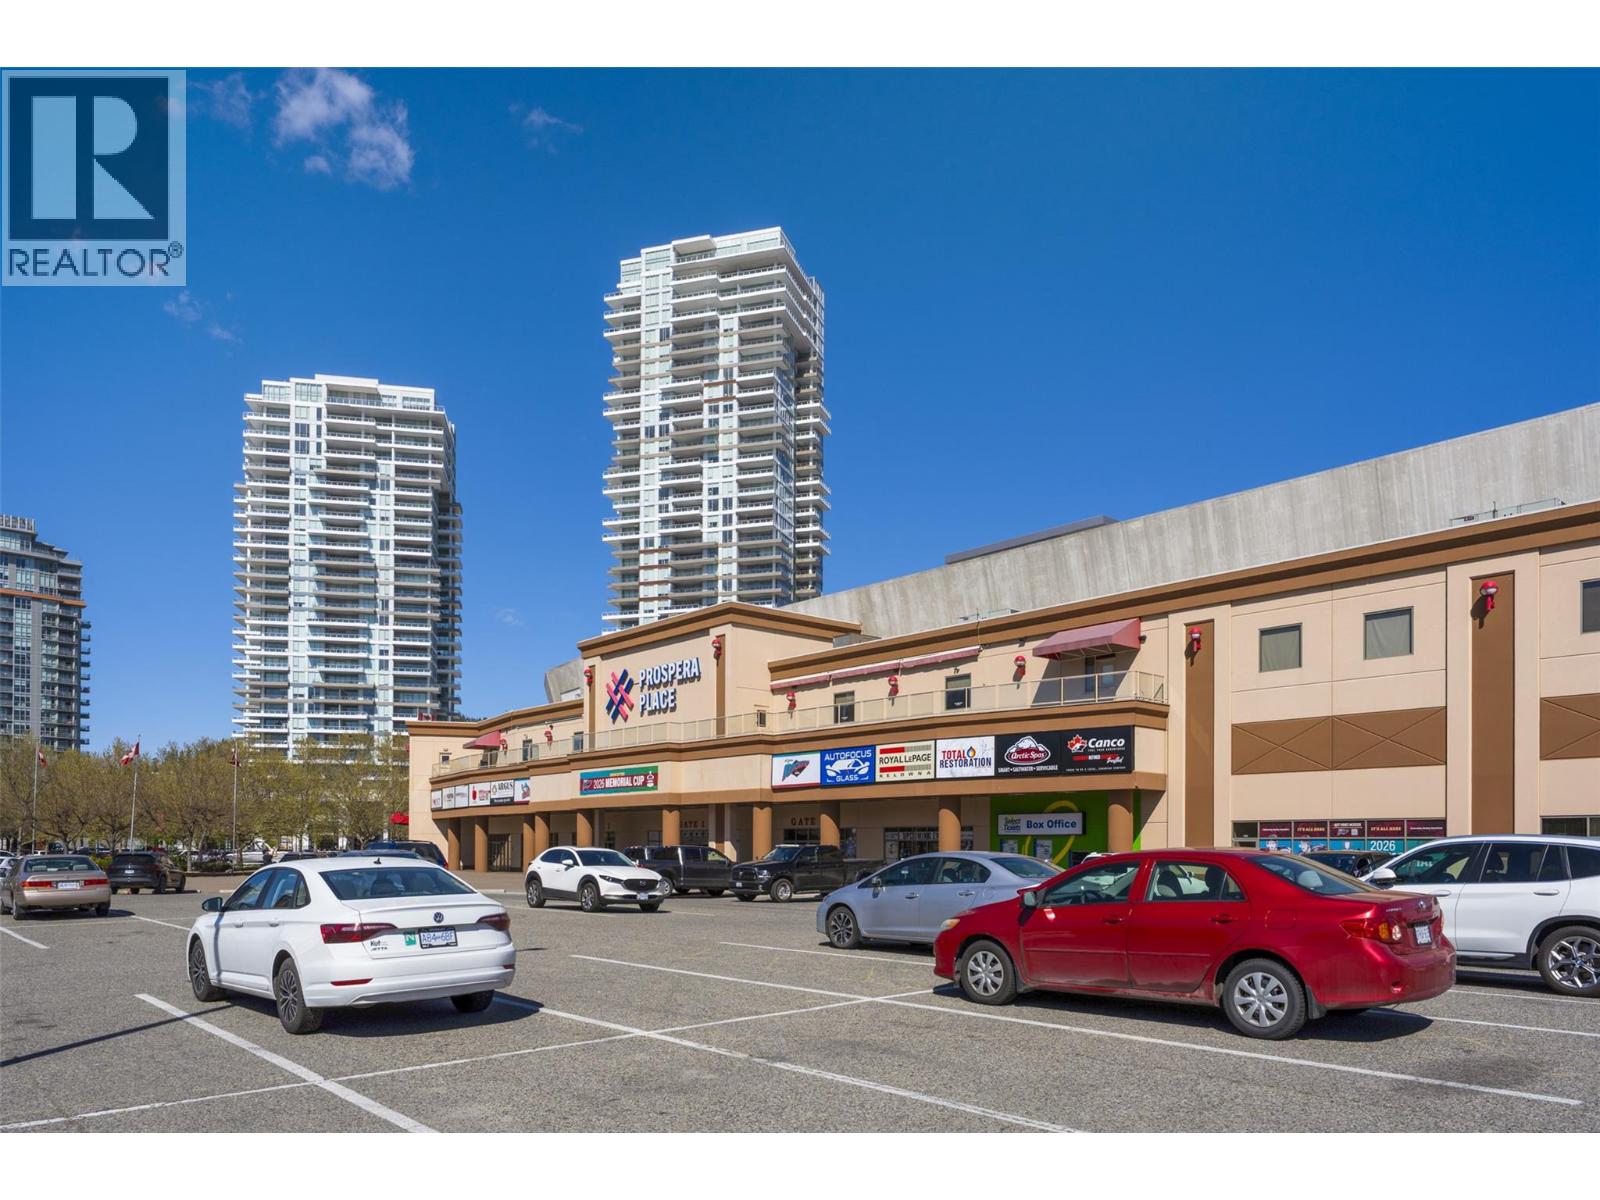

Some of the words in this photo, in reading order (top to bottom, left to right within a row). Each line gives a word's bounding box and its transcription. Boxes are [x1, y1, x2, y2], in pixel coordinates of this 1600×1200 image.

[640, 657, 701, 688] PROSPERA
[640, 688, 677, 712] PLACE
[1088, 738, 1125, 748] Canco
[824, 750, 872, 761] AUTOFOCUS
[879, 755, 904, 765] ROYAL
[942, 749, 967, 760] TOTAL
[1010, 751, 1029, 760] Arctic
[1029, 751, 1045, 760] Spas
[939, 757, 992, 769] RESTORATION
[605, 776, 633, 788] MEMORIAL
[633, 775, 645, 786] CUP
[835, 774, 858, 782] GLASS
[791, 817, 816, 826] GATE
[1026, 820, 1044, 829] Box
[1046, 819, 1077, 829] Office
[1370, 840, 1396, 851] 2026
